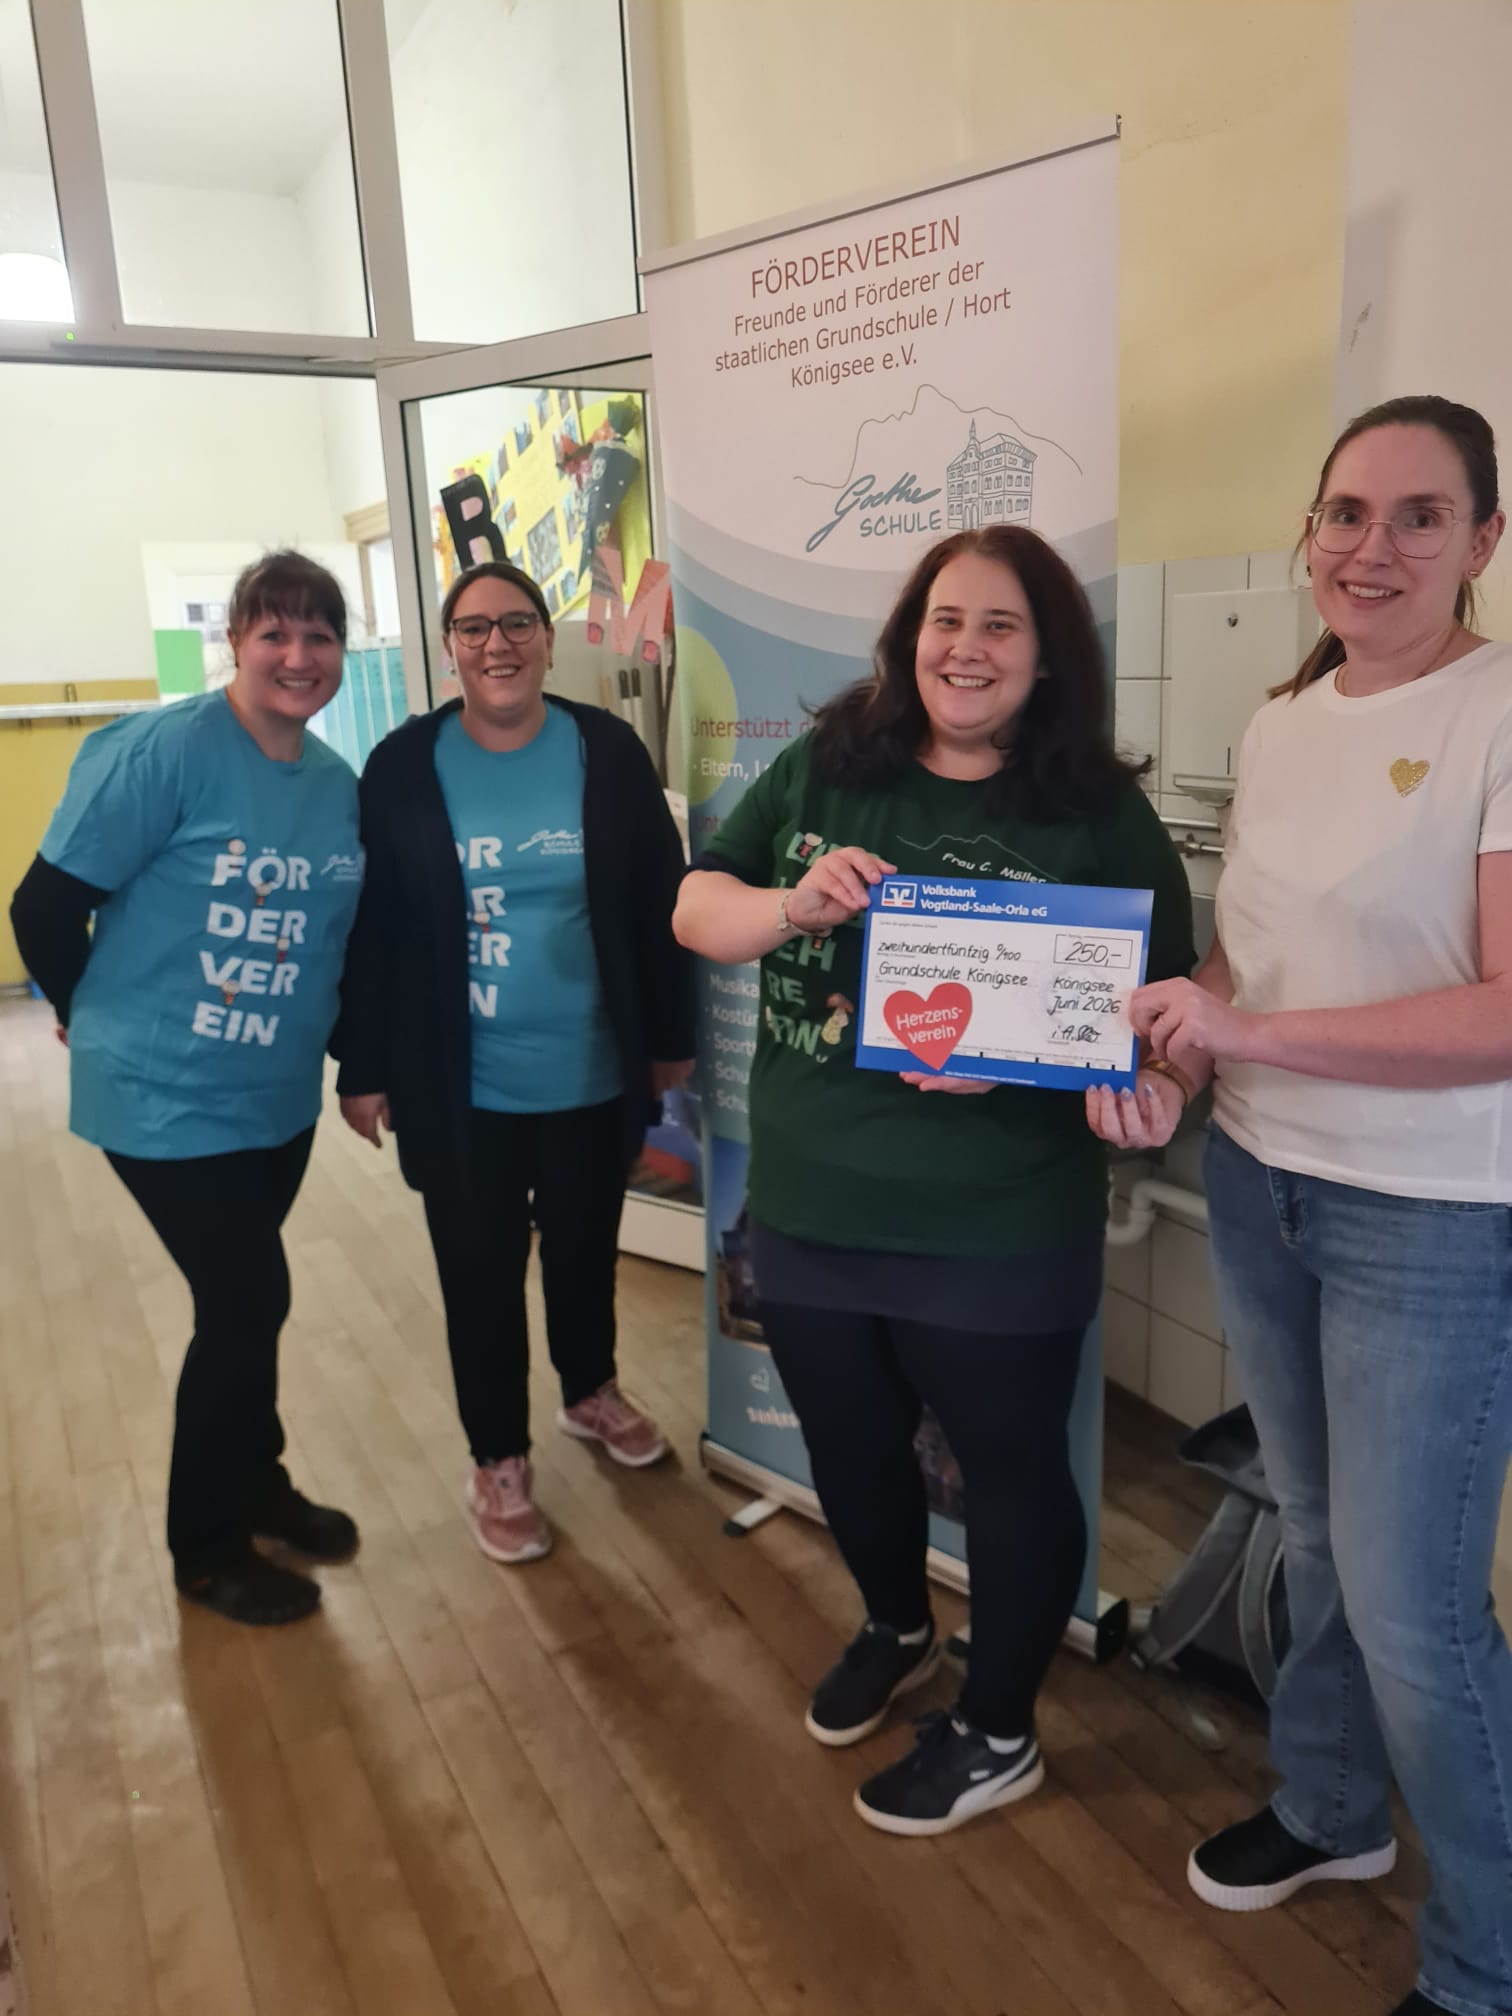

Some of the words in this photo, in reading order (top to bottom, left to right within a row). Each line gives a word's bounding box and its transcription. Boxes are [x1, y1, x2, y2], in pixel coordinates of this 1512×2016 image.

[751, 216, 960, 298] FÖRDERVEREIN
[735, 302, 806, 336] Freunde
[813, 290, 846, 318] und
[855, 270, 940, 308] Förderer
[948, 261, 984, 286] der
[715, 337, 809, 372] staatlichen
[816, 305, 937, 349] Grundschule
[945, 298, 954, 327] /
[964, 288, 1011, 318] Hort
[791, 356, 874, 388] Königsee
[883, 344, 917, 370] e.V.
[860, 509, 942, 537] SCHULE
[691, 717, 792, 739] Unterstützt
[211, 847, 311, 890] FÖR
[942, 853, 975, 870] Frau
[922, 884, 976, 898] Volksbank
[207, 901, 307, 944] DER
[920, 899, 1028, 917] Vogtland-Saale-Orla
[1031, 905, 1048, 917] eG
[200, 951, 299, 995] VER
[879, 960, 961, 981] Grundschule
[967, 967, 1029, 990] Königsee
[1053, 976, 1115, 996] Königsee
[896, 1006, 963, 1031] Herzens-
[1047, 996, 1079, 1016] Juni
[1082, 996, 1122, 1014] 2026
[192, 1001, 279, 1046] EIN
[908, 1025, 956, 1044] verein
